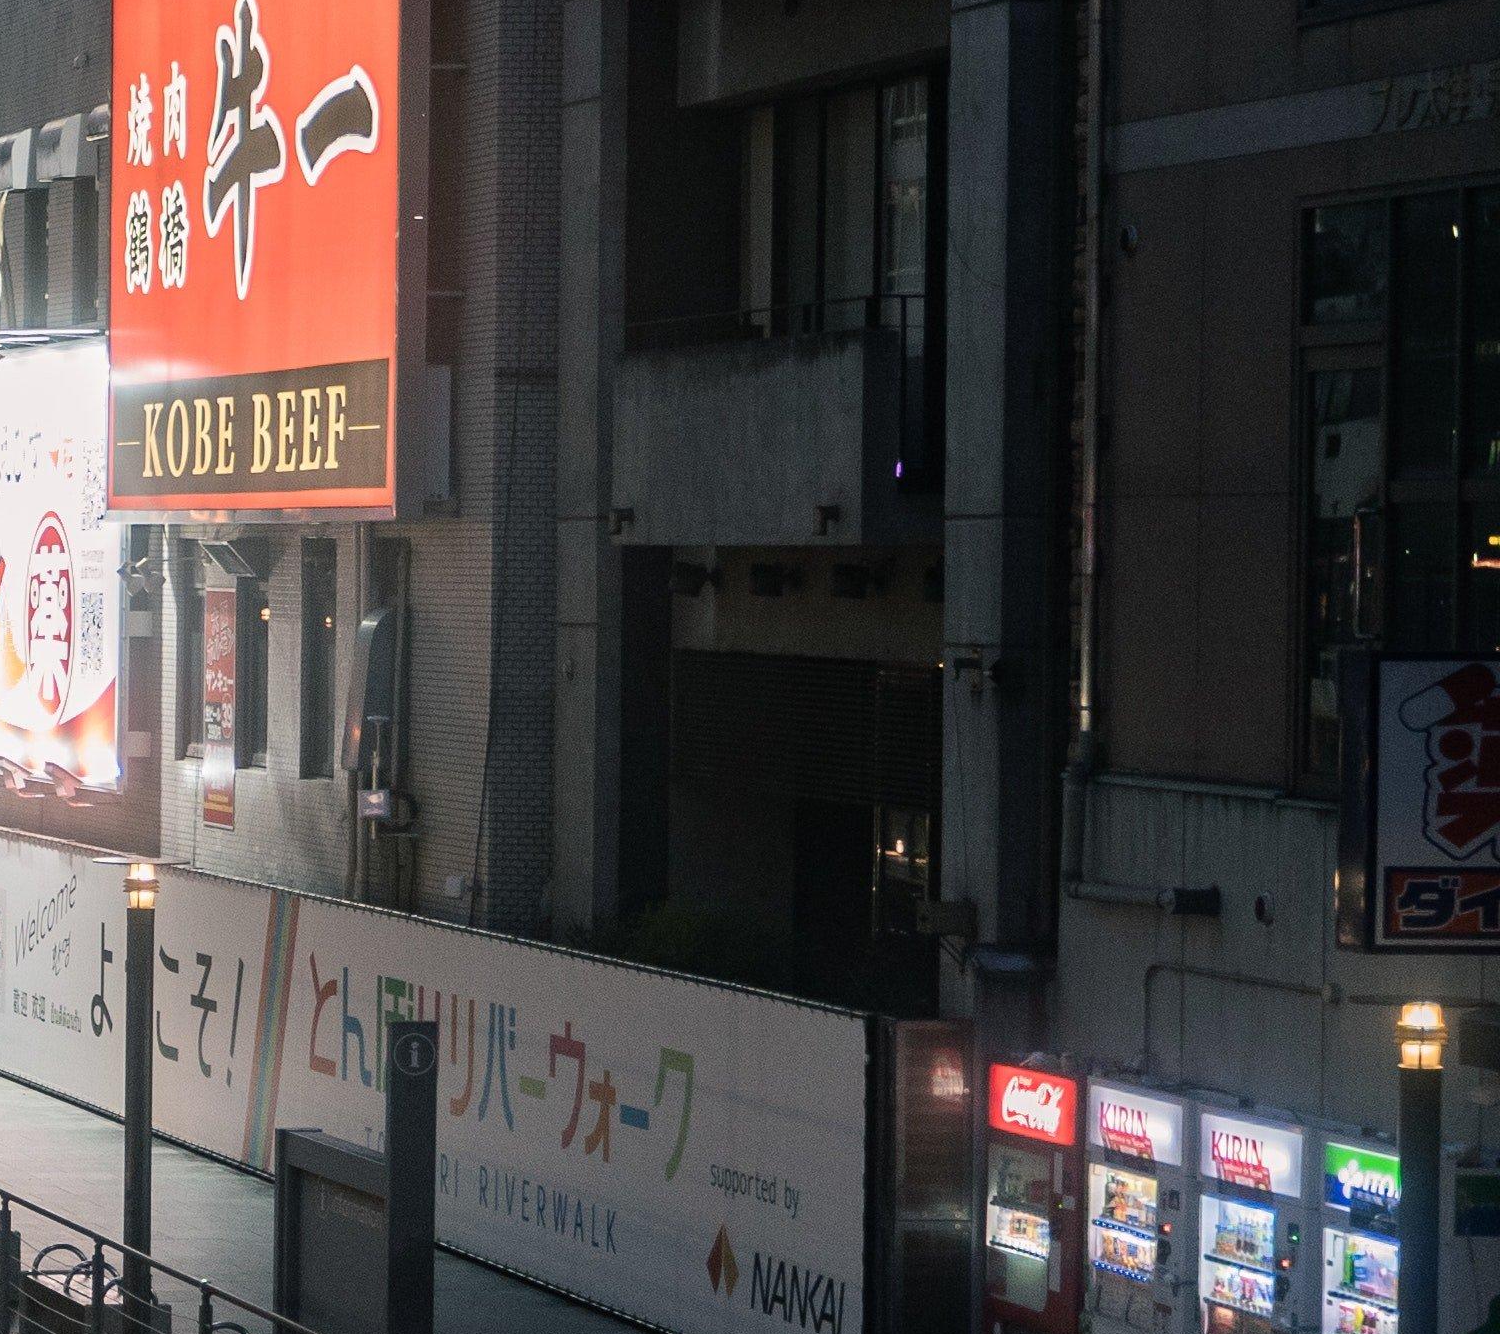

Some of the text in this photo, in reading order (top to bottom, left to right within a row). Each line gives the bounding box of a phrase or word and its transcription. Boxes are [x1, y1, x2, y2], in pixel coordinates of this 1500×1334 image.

[126, 60, 188, 167] 焼肉
[142, 396, 235, 479] KOBE
[251, 384, 347, 474] BEEF
[14, 874, 77, 967] Welcome
[90, 922, 244, 1088] よこそ!
[1099, 1101, 1148, 1139] KIRIN
[1211, 1129, 1264, 1167] KIRIN
[478, 1165, 617, 1255] RIVERWALK
[710, 1164, 800, 1218] supported by
